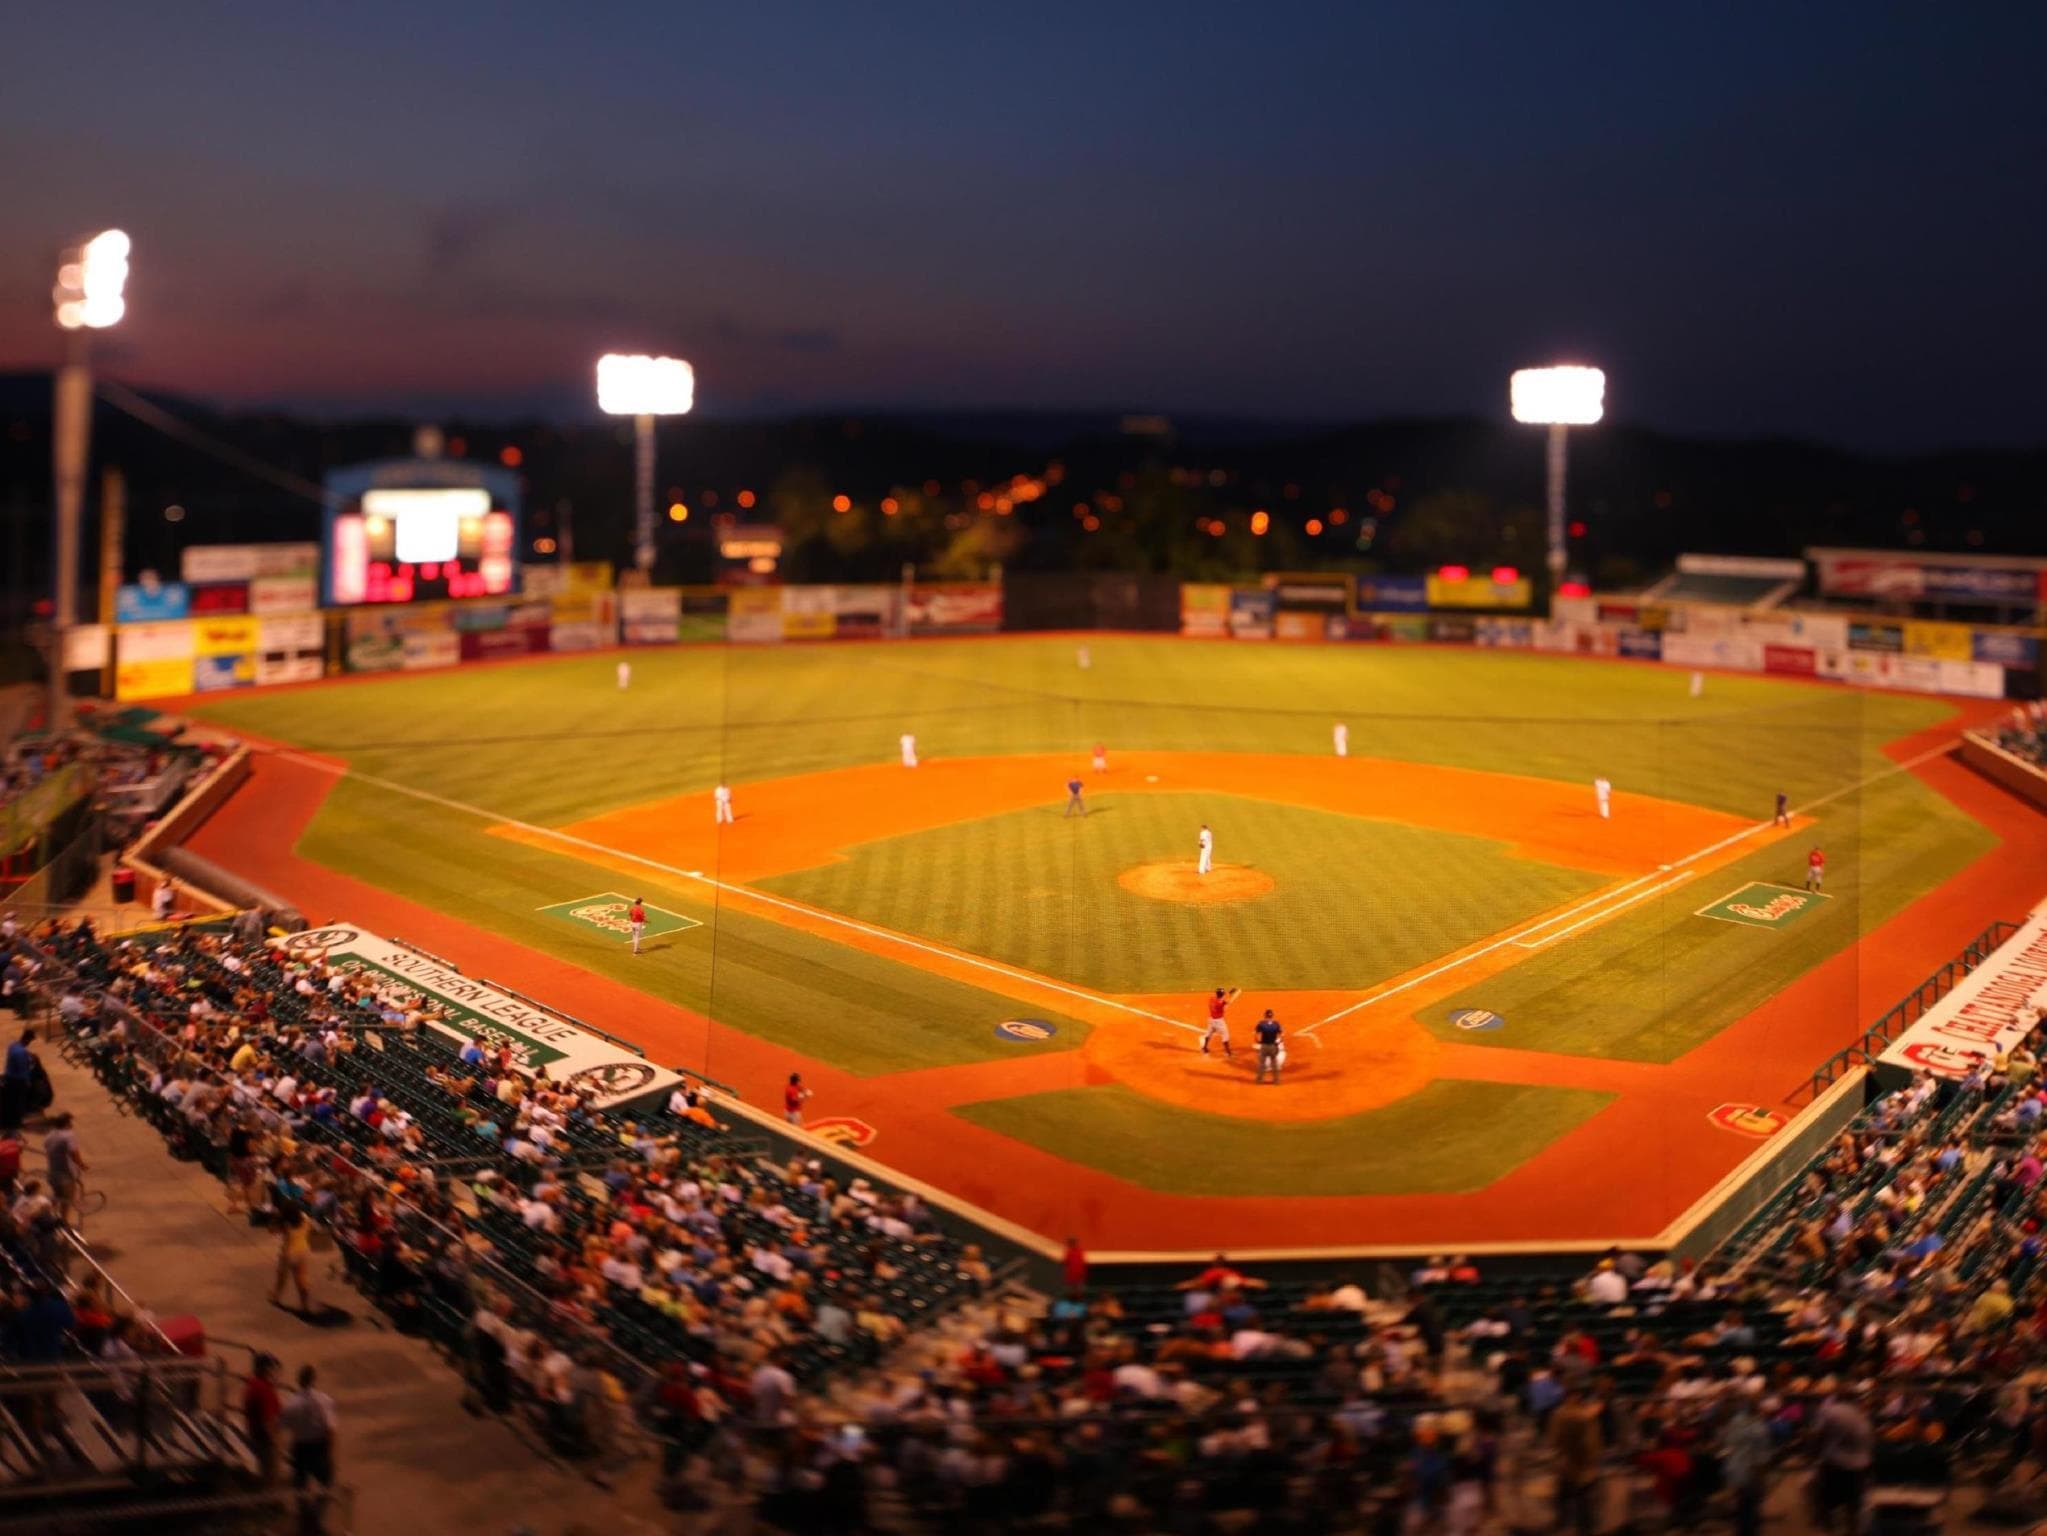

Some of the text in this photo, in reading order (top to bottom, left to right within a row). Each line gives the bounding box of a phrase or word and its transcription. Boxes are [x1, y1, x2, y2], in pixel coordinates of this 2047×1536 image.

[381, 953, 577, 1042] SOUTHERN LEAGUE
[1931, 970, 2047, 1045] CHATTANOOGA
